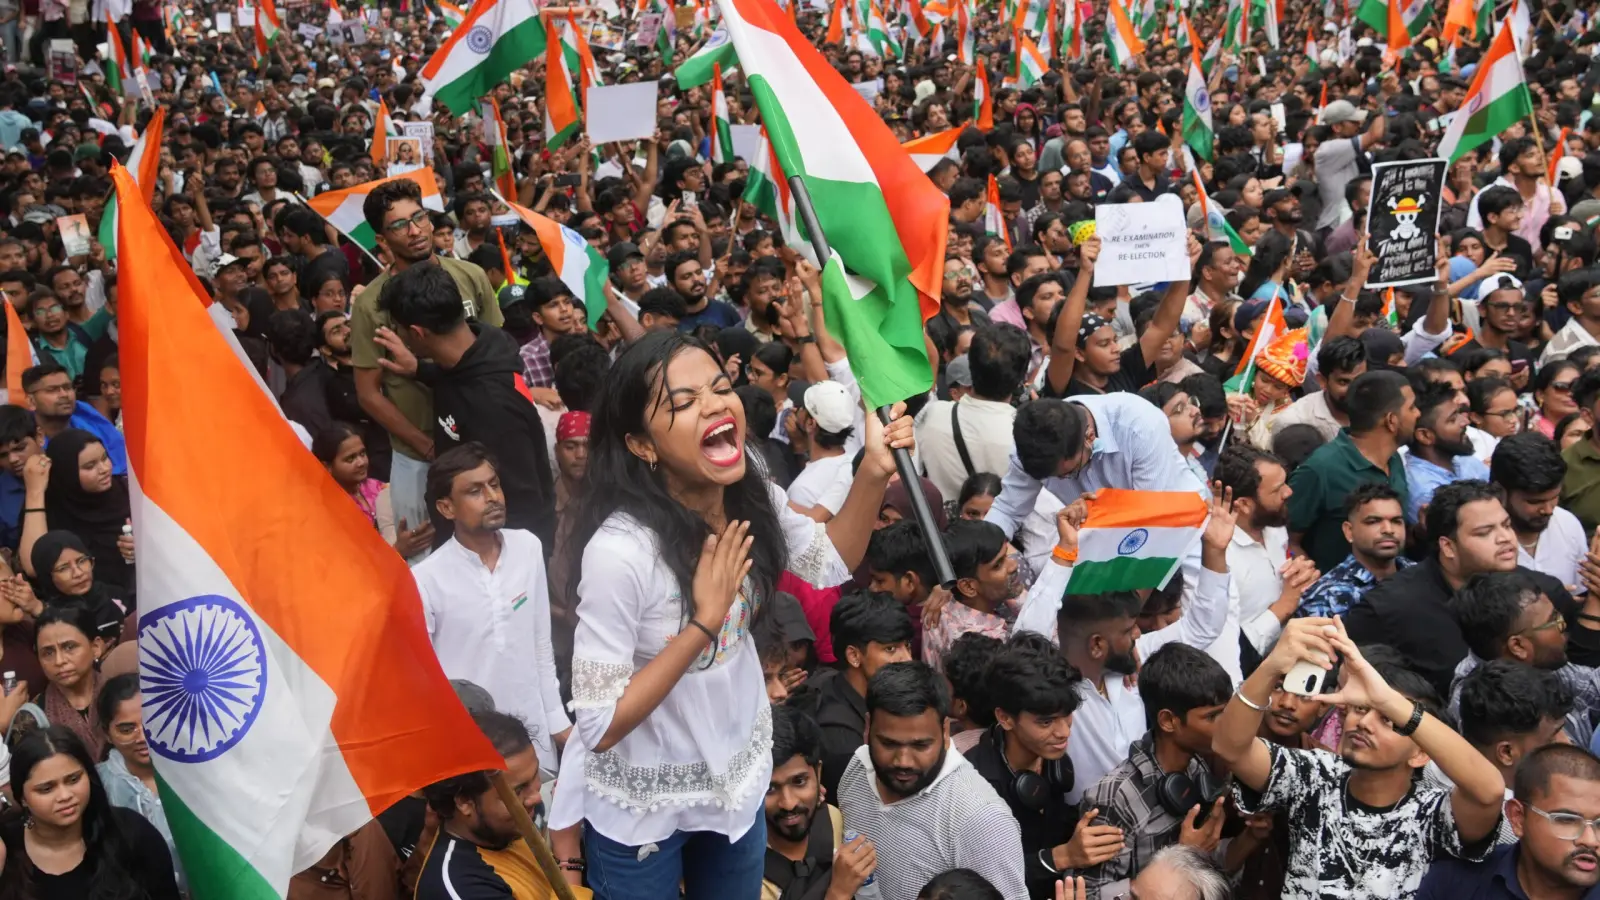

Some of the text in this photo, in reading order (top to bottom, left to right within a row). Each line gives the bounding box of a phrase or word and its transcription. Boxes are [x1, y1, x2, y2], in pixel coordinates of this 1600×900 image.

[1112, 232, 1175, 242] RE-EXAMINATION
[1377, 238, 1406, 259] They
[1118, 252, 1166, 261] RE-ELECTION
[1380, 261, 1412, 281] about
